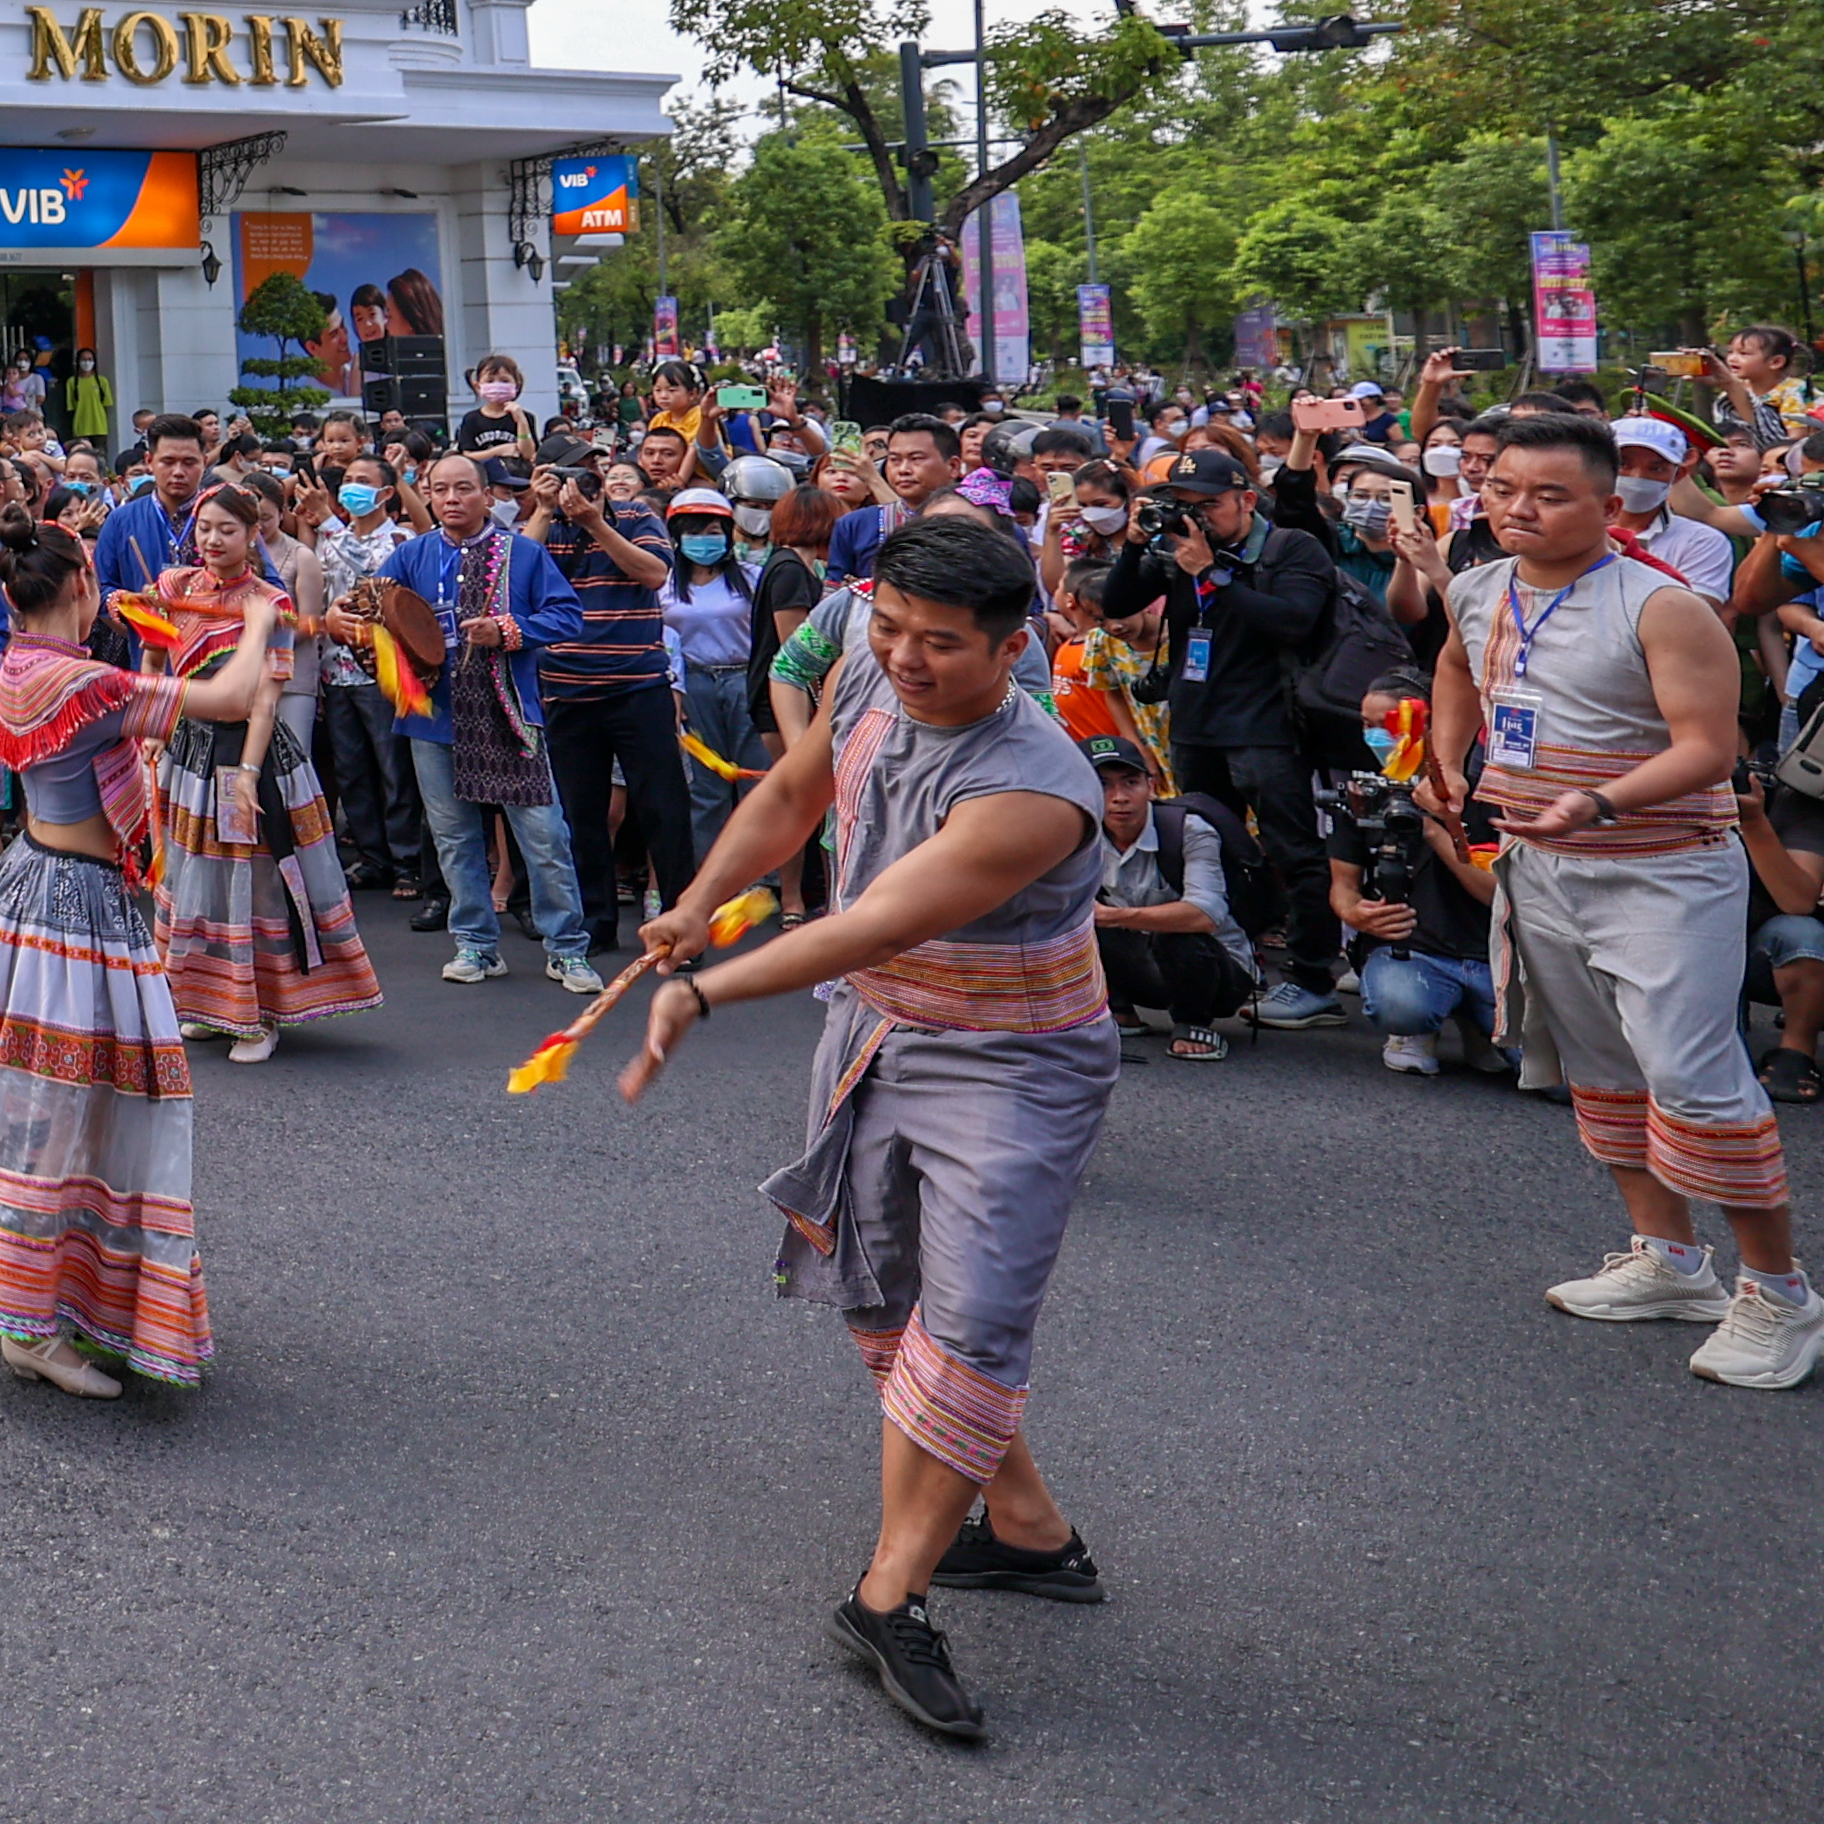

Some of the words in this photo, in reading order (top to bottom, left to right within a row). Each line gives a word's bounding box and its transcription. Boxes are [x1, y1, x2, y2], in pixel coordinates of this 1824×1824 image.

[23, 3, 347, 90] MORIN
[559, 172, 589, 189] VIB
[581, 209, 623, 228] ATM
[1178, 455, 1196, 474] LA
